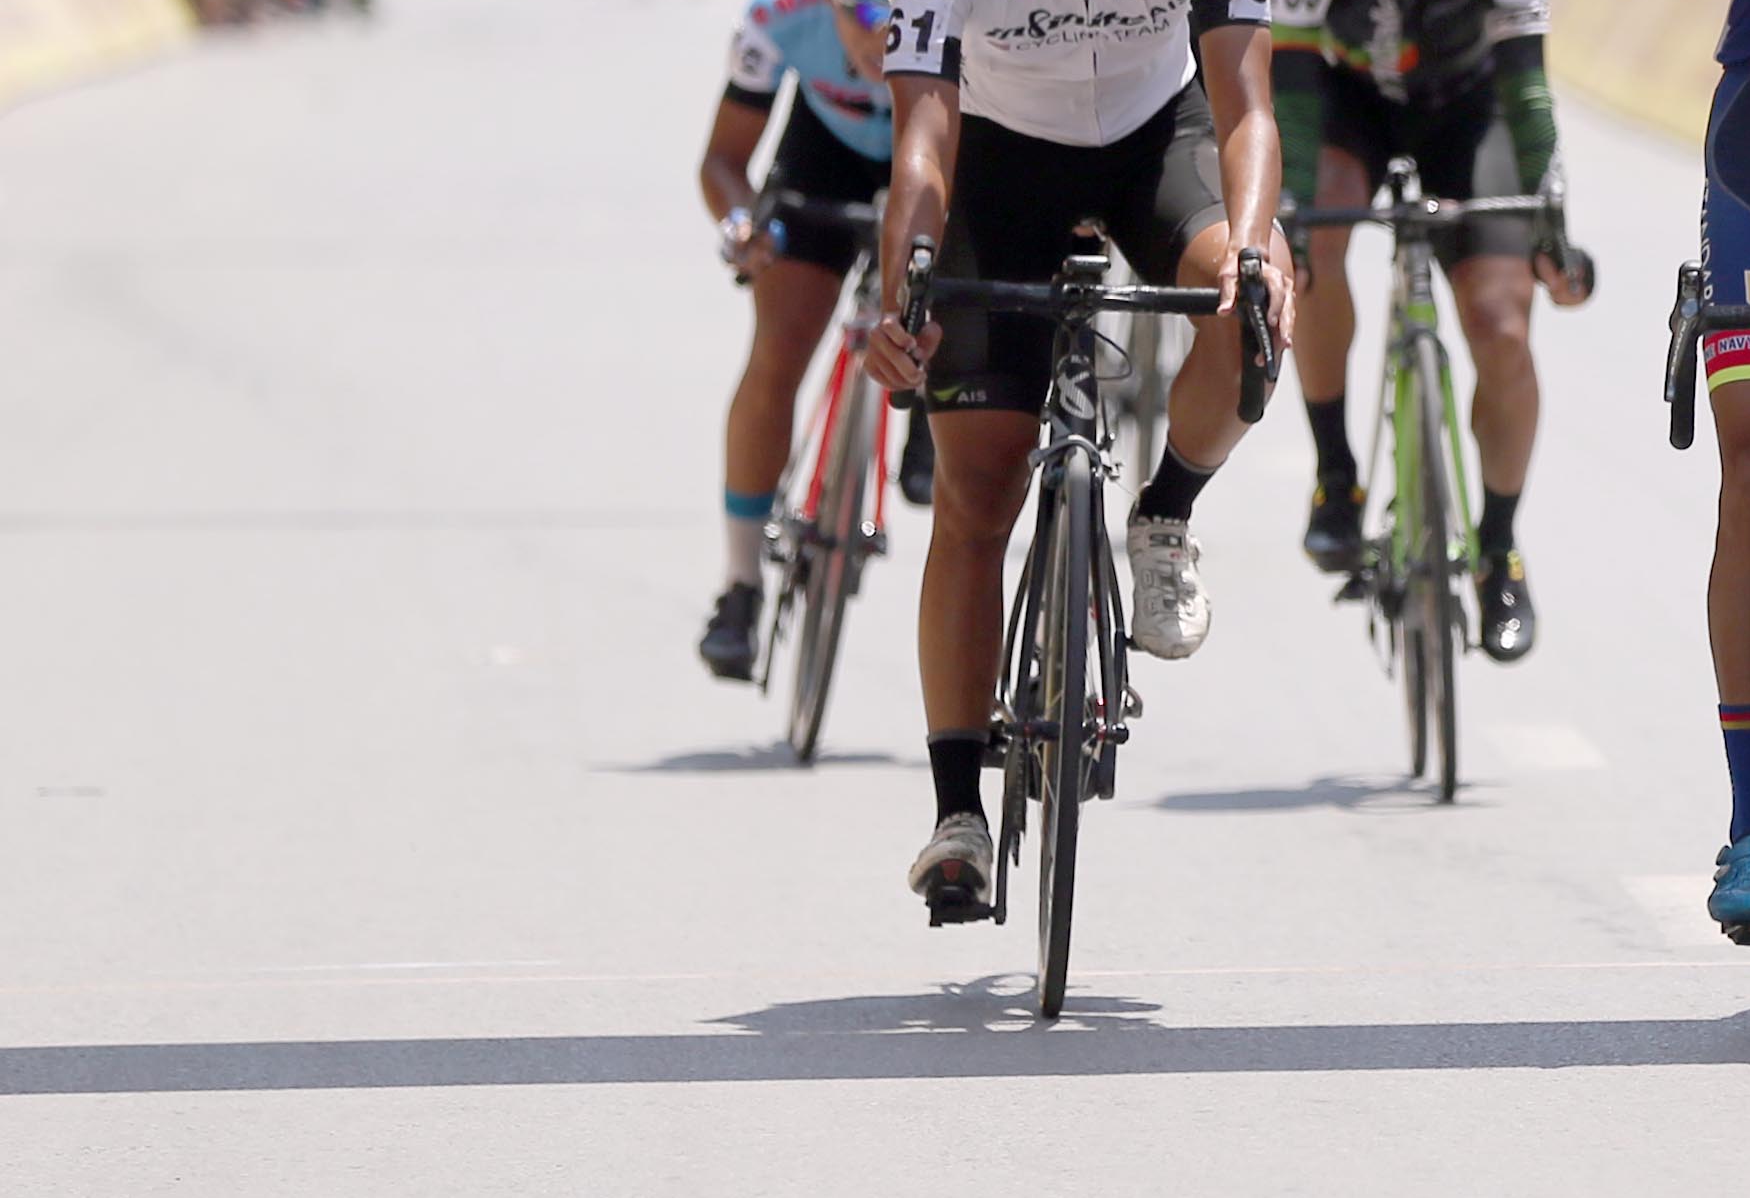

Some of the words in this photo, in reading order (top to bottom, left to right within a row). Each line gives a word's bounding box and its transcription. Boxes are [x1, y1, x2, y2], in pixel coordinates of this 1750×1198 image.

[885, 8, 935, 53] 61
[1113, 19, 1171, 42] TEAM
[957, 390, 987, 403] AIS
